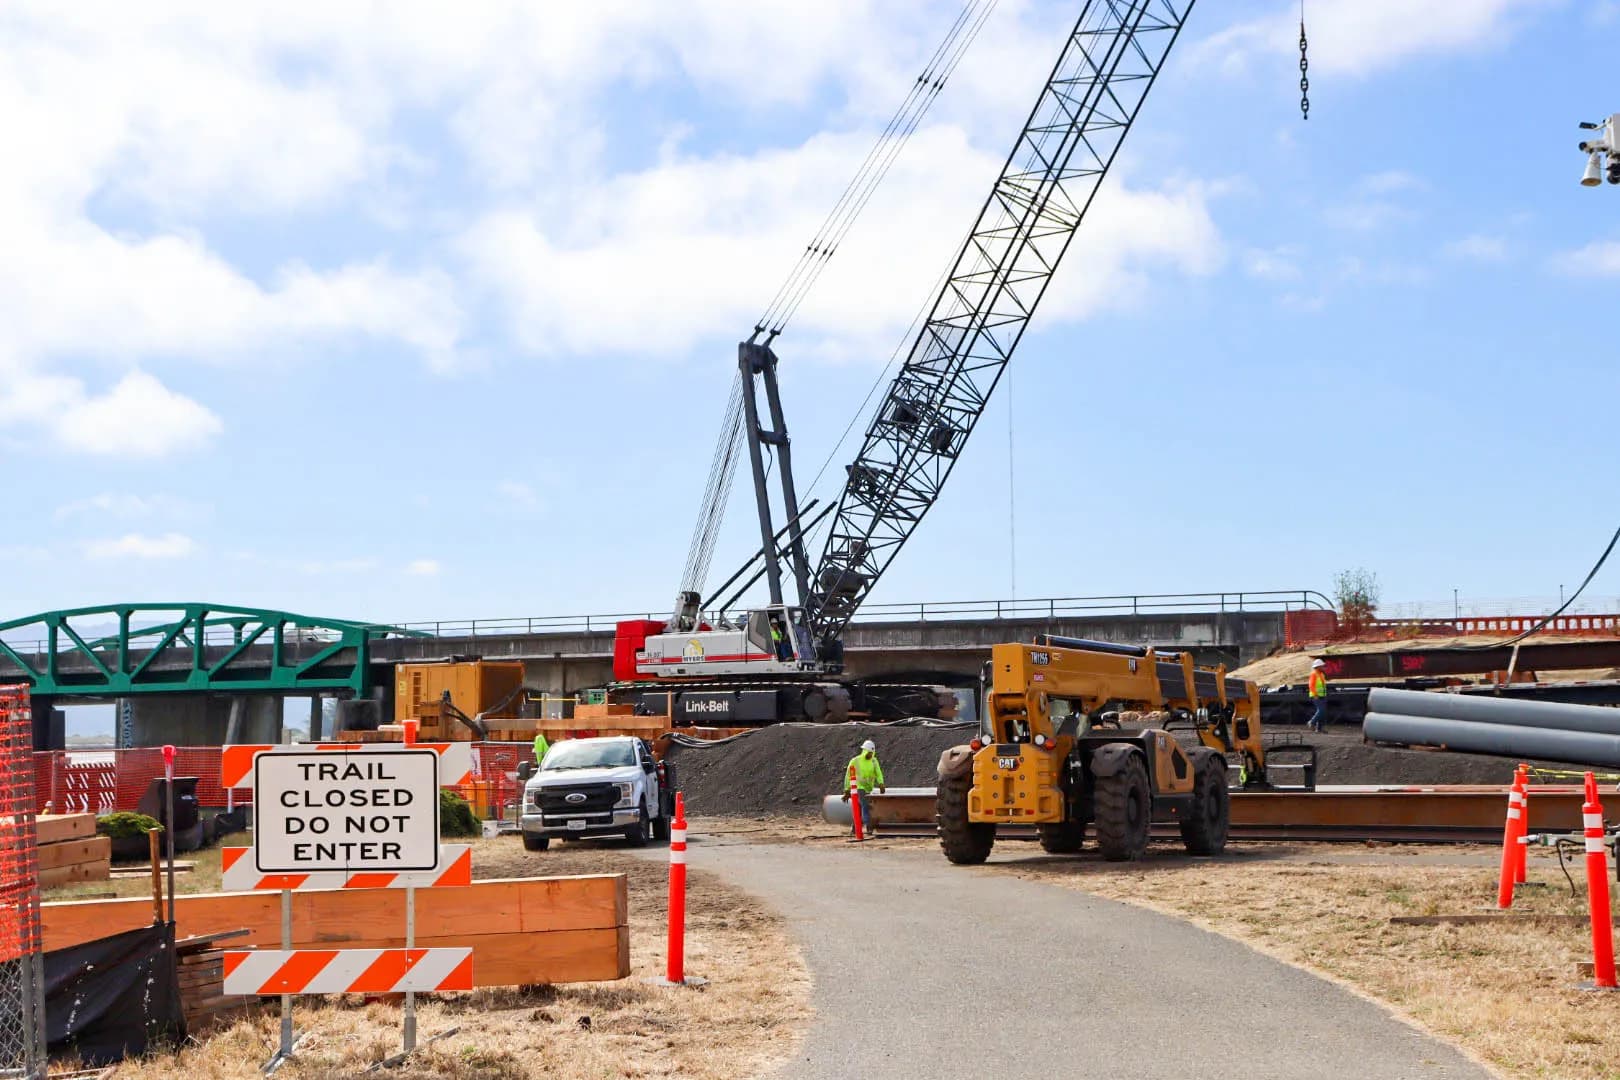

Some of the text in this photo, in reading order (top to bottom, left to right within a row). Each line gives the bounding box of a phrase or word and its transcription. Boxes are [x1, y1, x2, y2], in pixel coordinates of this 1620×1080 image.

[685, 699, 729, 713] Link-Belt
[297, 762, 396, 781] TRAIL
[999, 758, 1015, 769] CAT
[280, 788, 414, 808] CLOSED
[285, 815, 411, 835] DO NOT
[293, 842, 401, 861] ENTER
